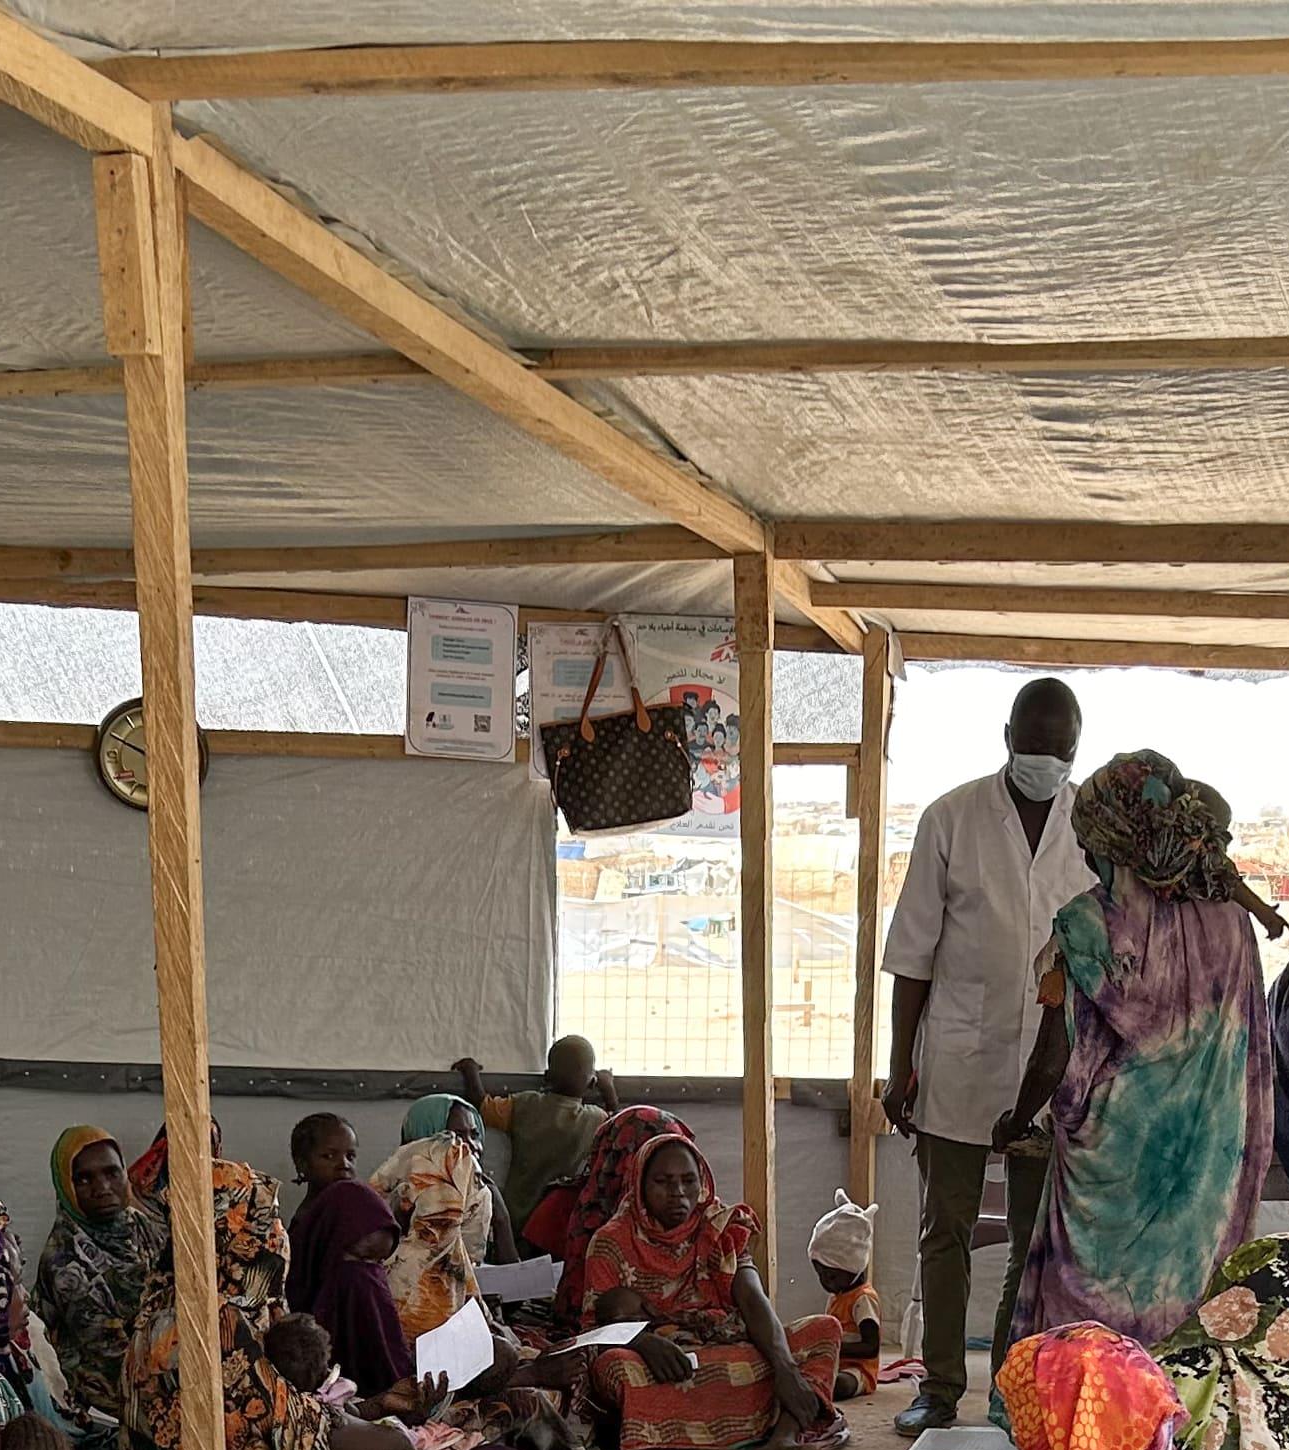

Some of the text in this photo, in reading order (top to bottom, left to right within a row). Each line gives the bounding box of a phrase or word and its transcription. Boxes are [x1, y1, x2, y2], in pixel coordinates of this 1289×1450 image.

[698, 623, 706, 637] في
[691, 668, 714, 681] مجال
[716, 674, 726, 684] لا
[670, 819, 693, 831] العلاج
